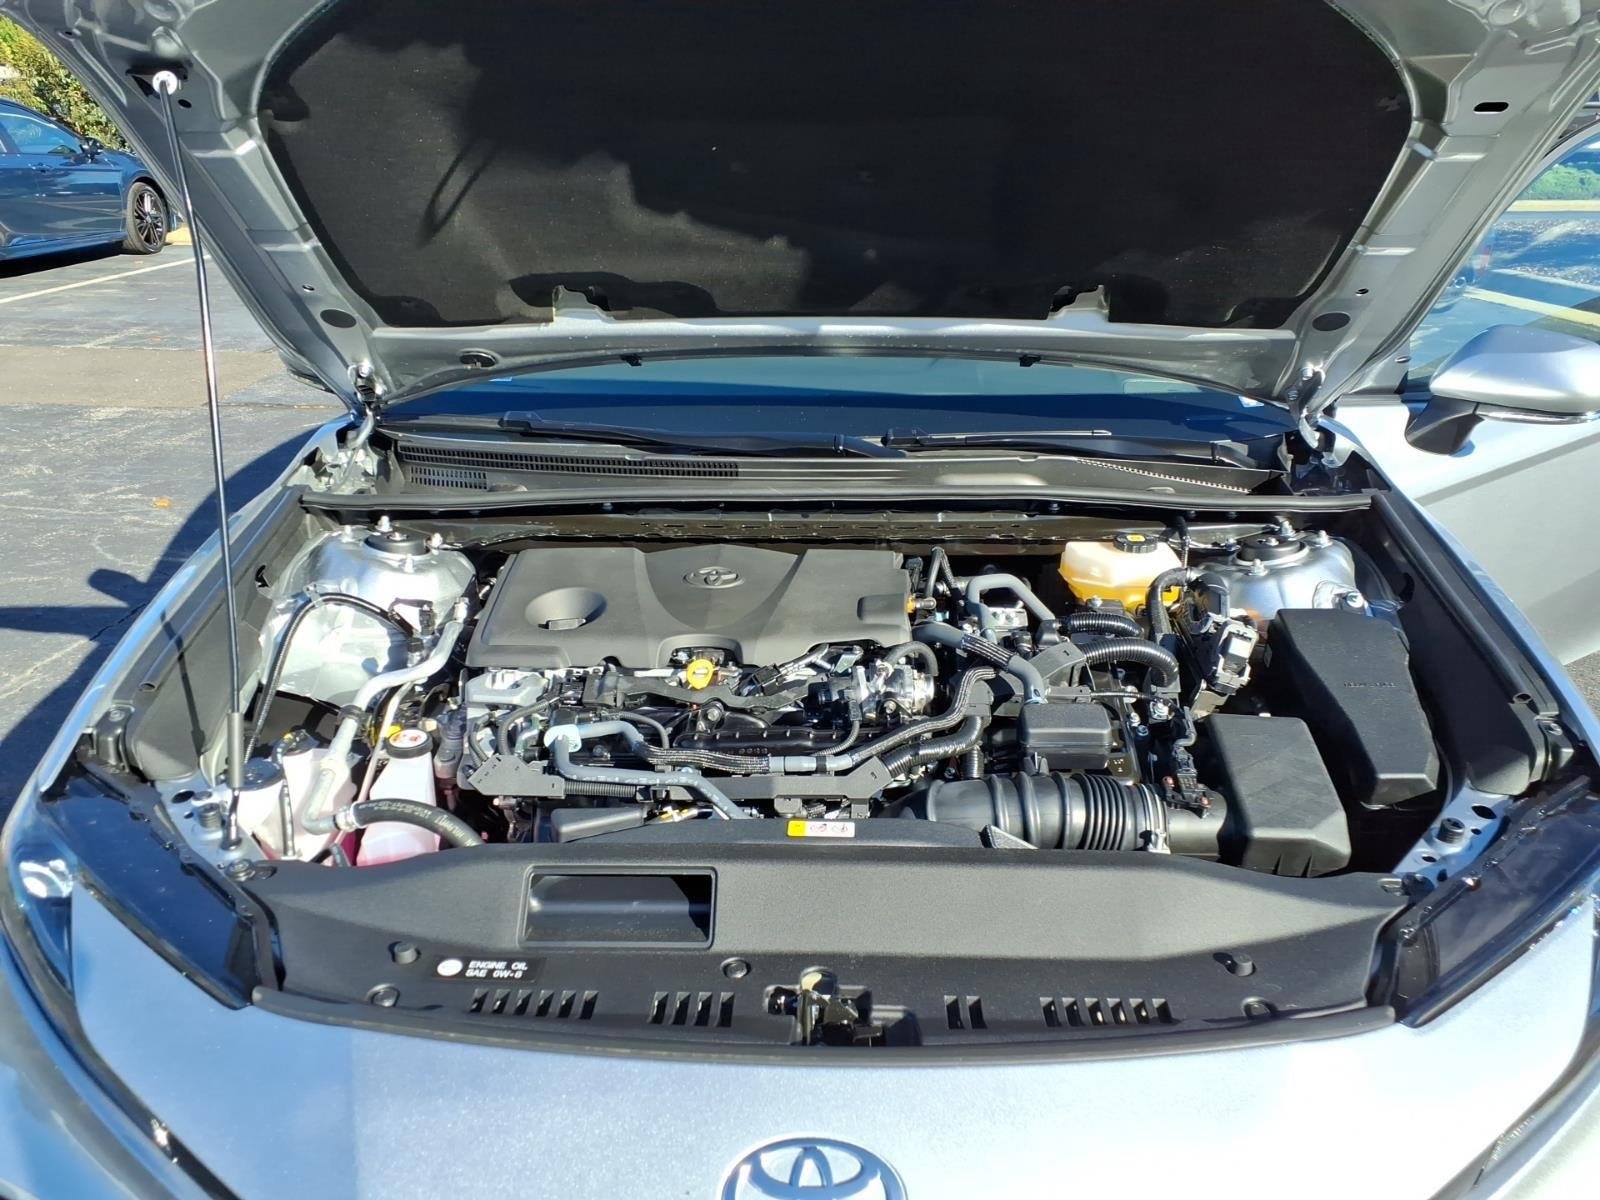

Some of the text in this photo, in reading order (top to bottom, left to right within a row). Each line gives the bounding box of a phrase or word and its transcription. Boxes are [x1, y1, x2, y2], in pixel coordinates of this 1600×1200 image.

[468, 960, 529, 971] ENGINE OIL
[465, 969, 488, 978] SAE
